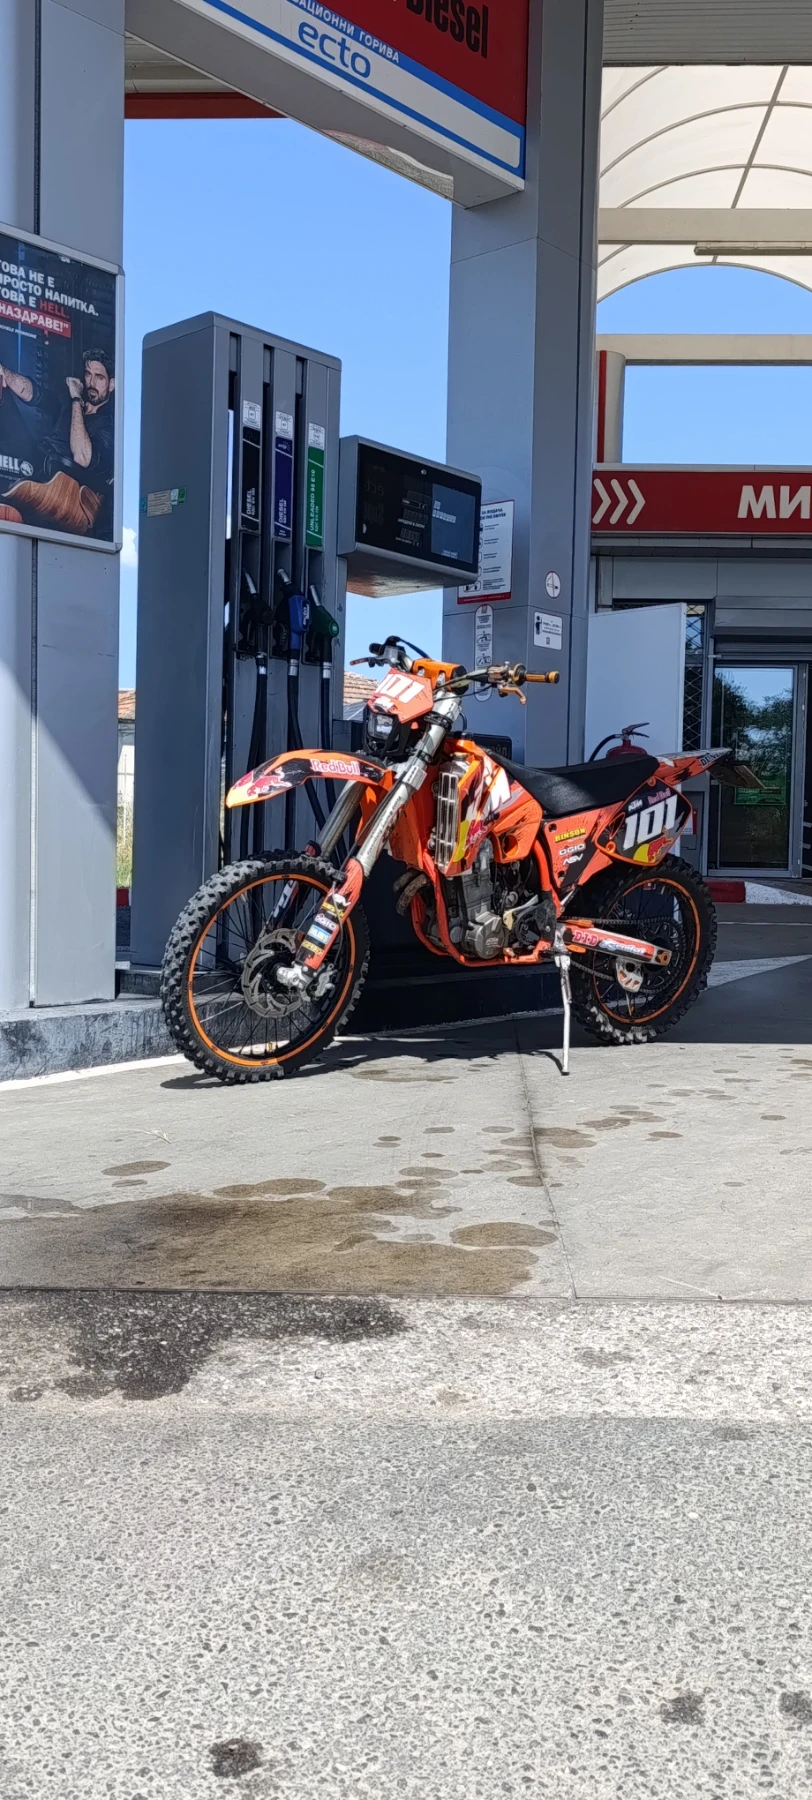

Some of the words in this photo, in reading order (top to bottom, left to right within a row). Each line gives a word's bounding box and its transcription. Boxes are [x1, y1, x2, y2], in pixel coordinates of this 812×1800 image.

[406, 0, 489, 59] esel
[298, 21, 371, 79] ecto
[359, 31, 400, 64] ГОРИВА
[0, 259, 26, 279] ОВА
[28, 270, 45, 285] НЕ
[47, 276, 55, 288] Е
[0, 286, 26, 305] ОВА
[45, 288, 99, 317] НАПИТКА.
[737, 485, 811, 519] МИ
[555, 828, 586, 843] HINSON
[623, 794, 678, 851] 101
[559, 843, 585, 856] OGIO
[563, 853, 584, 866] ASV
